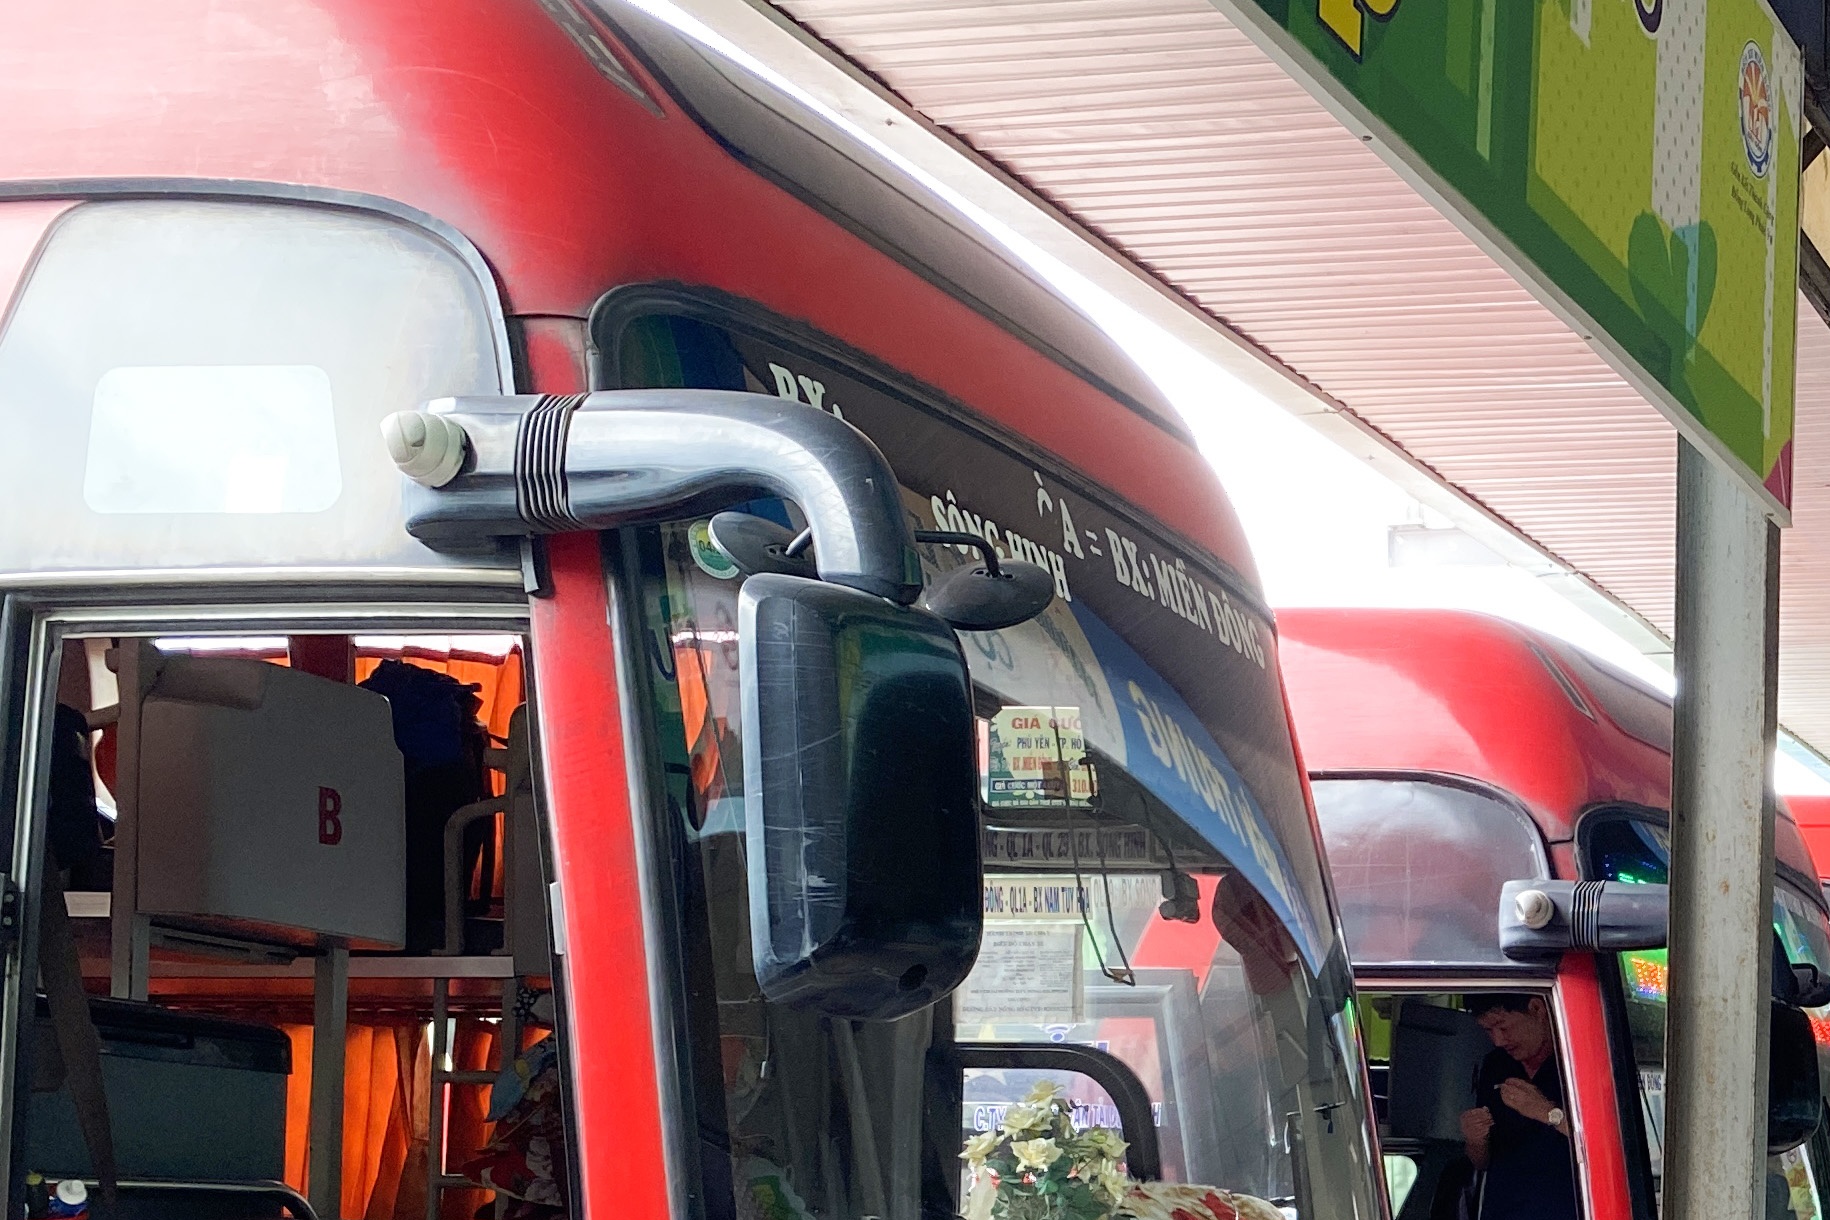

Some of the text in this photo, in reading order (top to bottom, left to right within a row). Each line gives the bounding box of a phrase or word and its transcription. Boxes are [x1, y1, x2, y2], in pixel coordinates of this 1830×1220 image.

[1011, 714, 1041, 730] GIÁ
[317, 786, 344, 845] B
[1044, 887, 1060, 913] NAM
